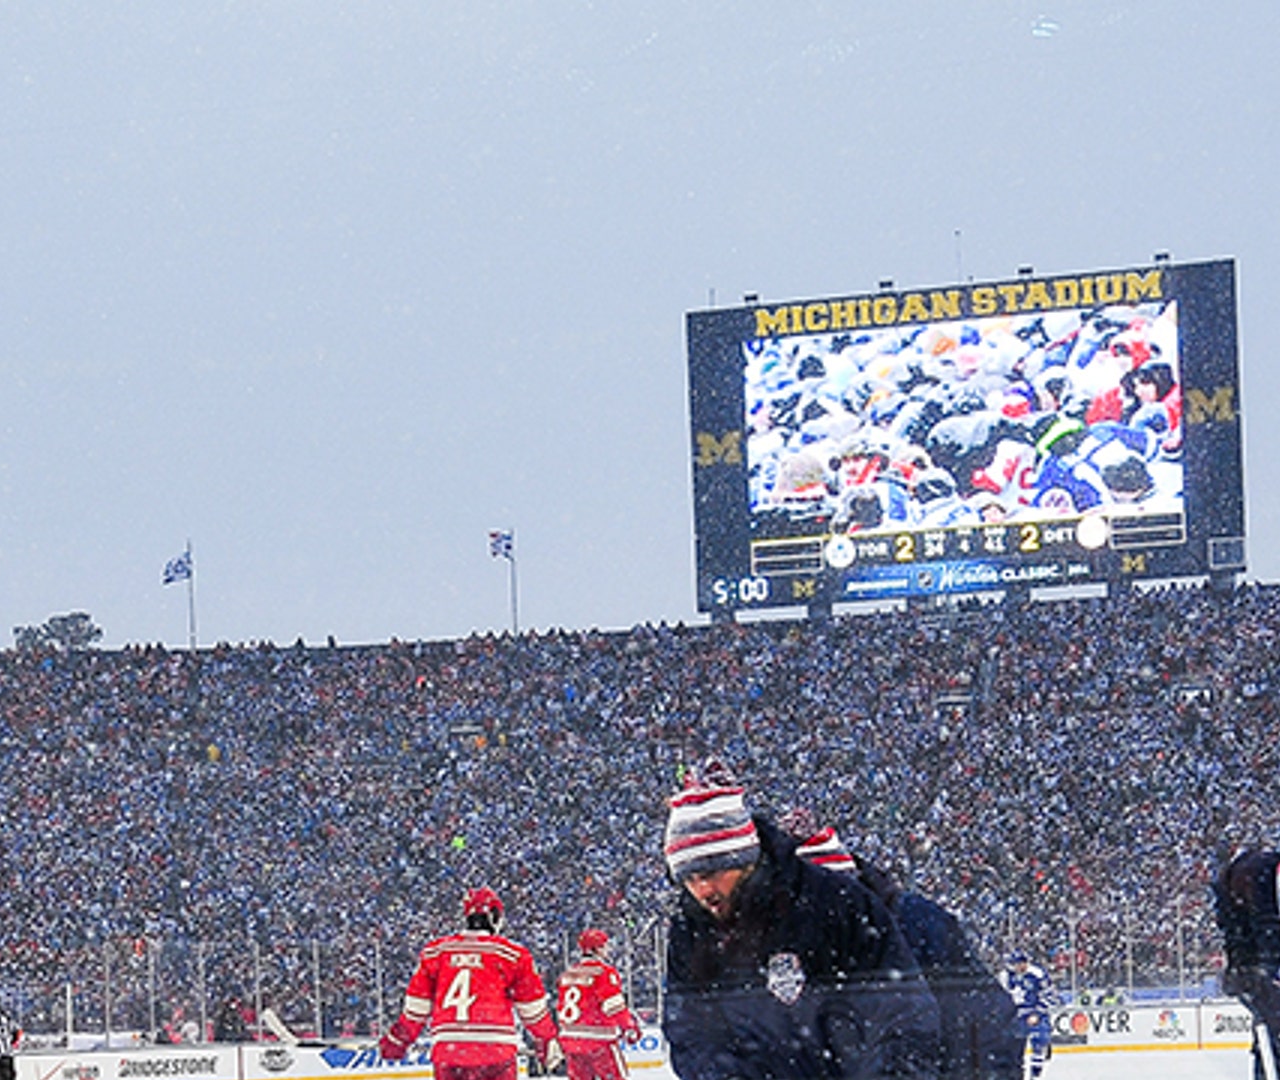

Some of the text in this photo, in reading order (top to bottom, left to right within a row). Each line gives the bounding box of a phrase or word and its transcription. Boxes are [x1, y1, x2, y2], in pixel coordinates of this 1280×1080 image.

[755, 270, 1163, 336] MICHIGAN STADIUM
[894, 535, 915, 561] 2
[1020, 523, 1041, 550] 2
[1044, 528, 1074, 543] DET
[712, 577, 769, 604] 5:00
[442, 968, 477, 1022] 4
[559, 986, 581, 1024] 8
[1053, 1010, 1132, 1036] COVER
[118, 1055, 220, 1078] BRIDGESTONE
